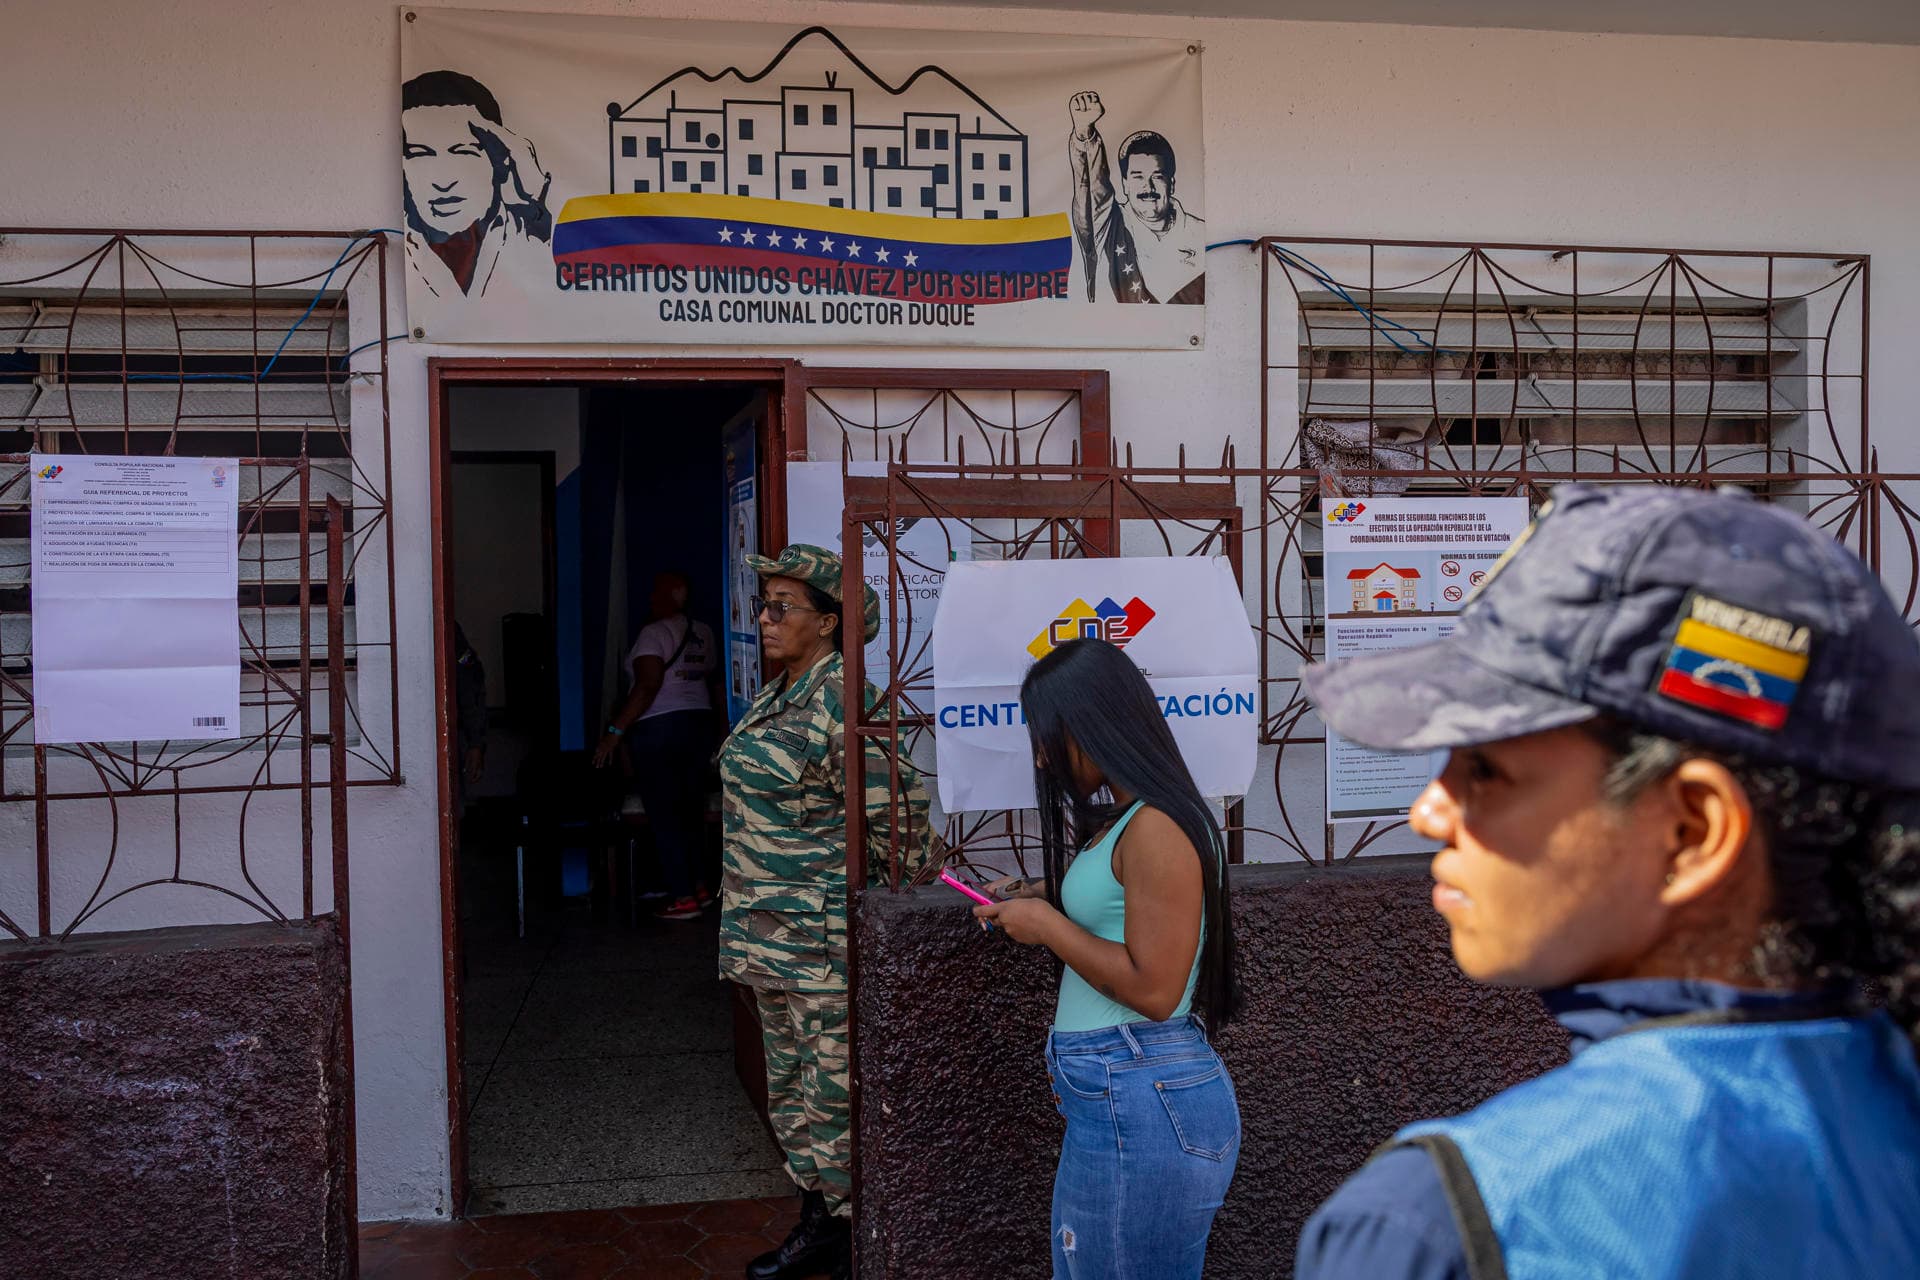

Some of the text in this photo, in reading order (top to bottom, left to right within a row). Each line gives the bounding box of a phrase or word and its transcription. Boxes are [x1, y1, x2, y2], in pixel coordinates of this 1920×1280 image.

[556, 260, 1069, 299] CERRITOS UNIDOS CHÁVEZ POR SIEMPRE
[659, 299, 975, 327] CASA COMUNAL DOCTOR DUQUE
[1374, 514, 1397, 522] NORMAS
[1399, 513, 1405, 521] DE
[1369, 524, 1397, 532] EFECTIVOS
[1413, 523, 1443, 532] OPERACIÓN
[1445, 523, 1472, 532] REPÚBLICA
[1350, 535, 1393, 543] COORDINADORA
[1406, 534, 1443, 542] COORDINADOR
[1484, 533, 1510, 542] VOTACIÓN
[884, 589, 940, 600] EECTOR
[1691, 595, 1811, 655] VENEZUELA
[940, 702, 1029, 728] CENT
